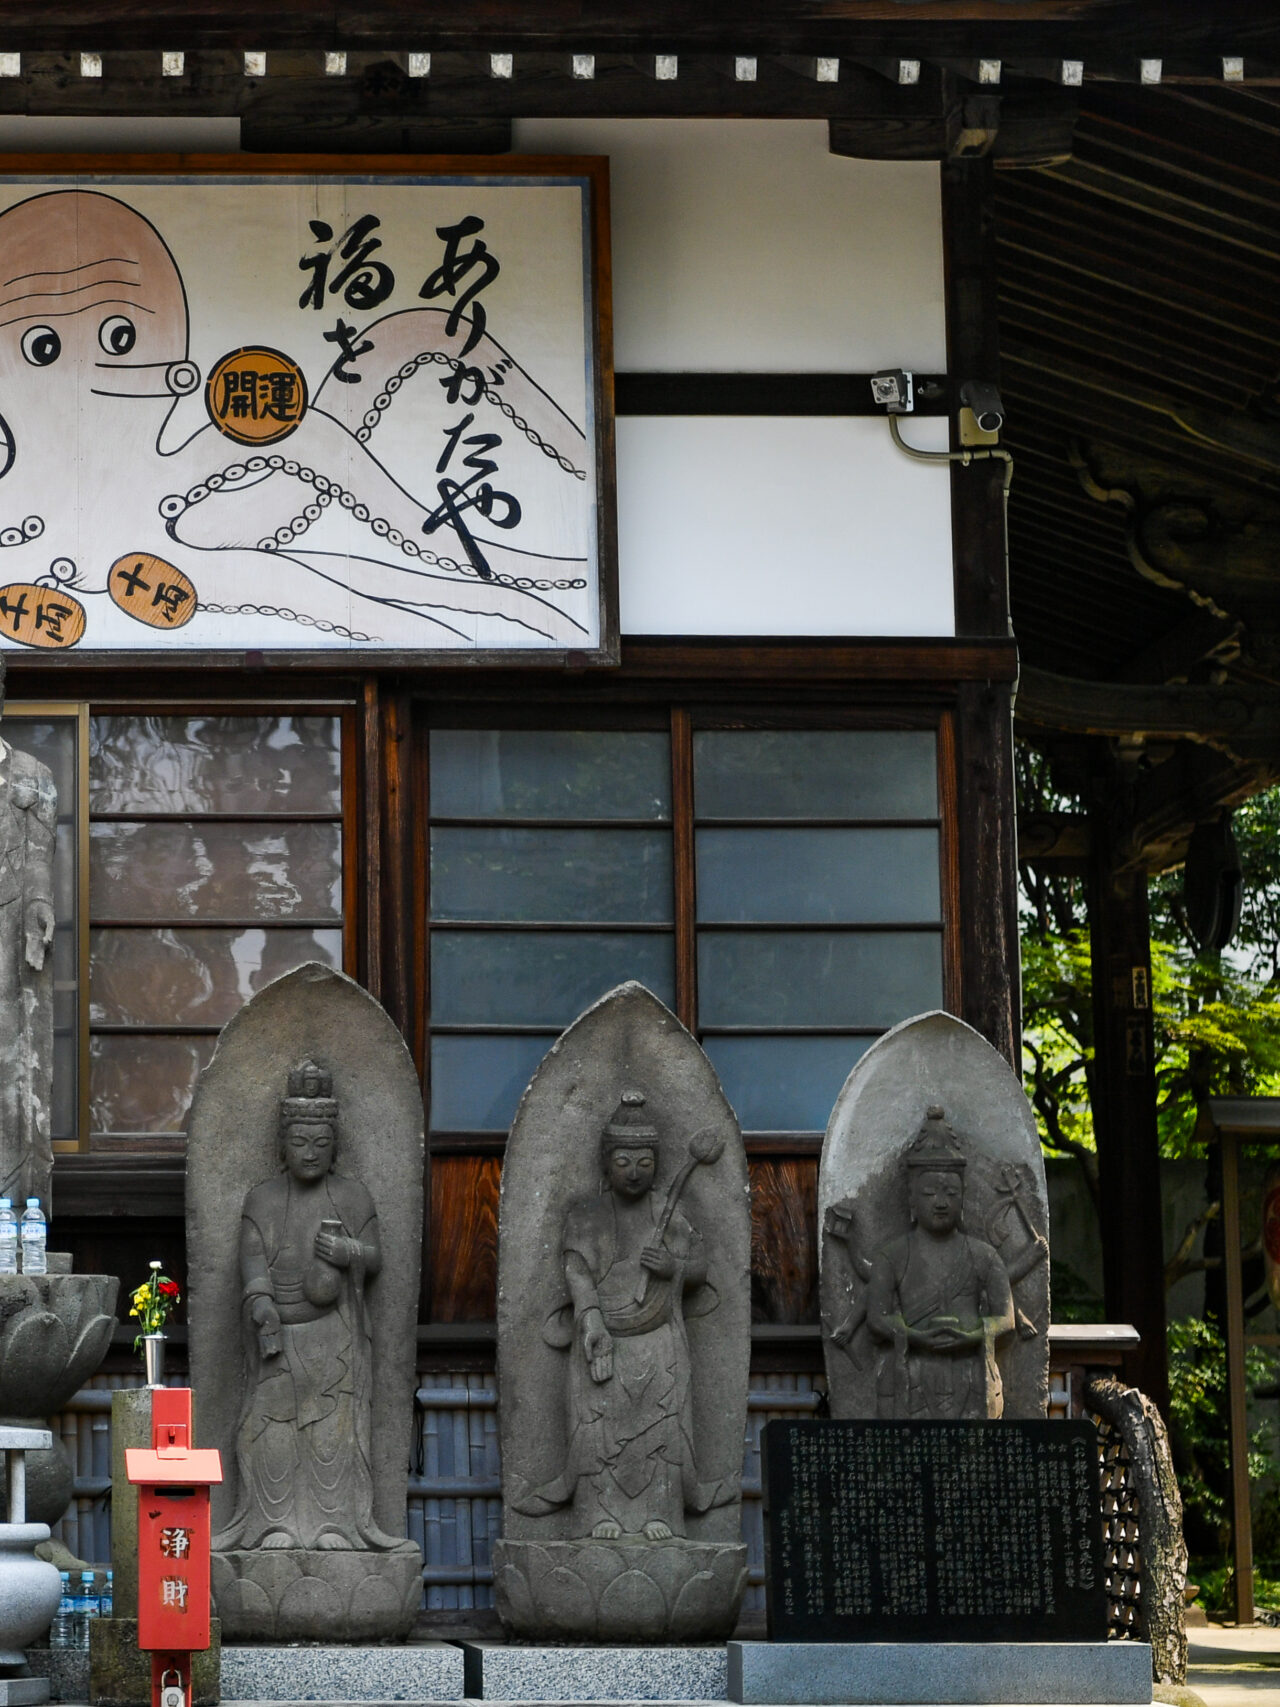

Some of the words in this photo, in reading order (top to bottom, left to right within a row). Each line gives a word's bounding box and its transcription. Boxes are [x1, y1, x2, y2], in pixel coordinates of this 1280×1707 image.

[299, 214, 395, 383] 福を
[220, 370, 297, 421] 開運
[419, 215, 521, 580] ありがたや
[161, 1528, 189, 1608] 浄財
